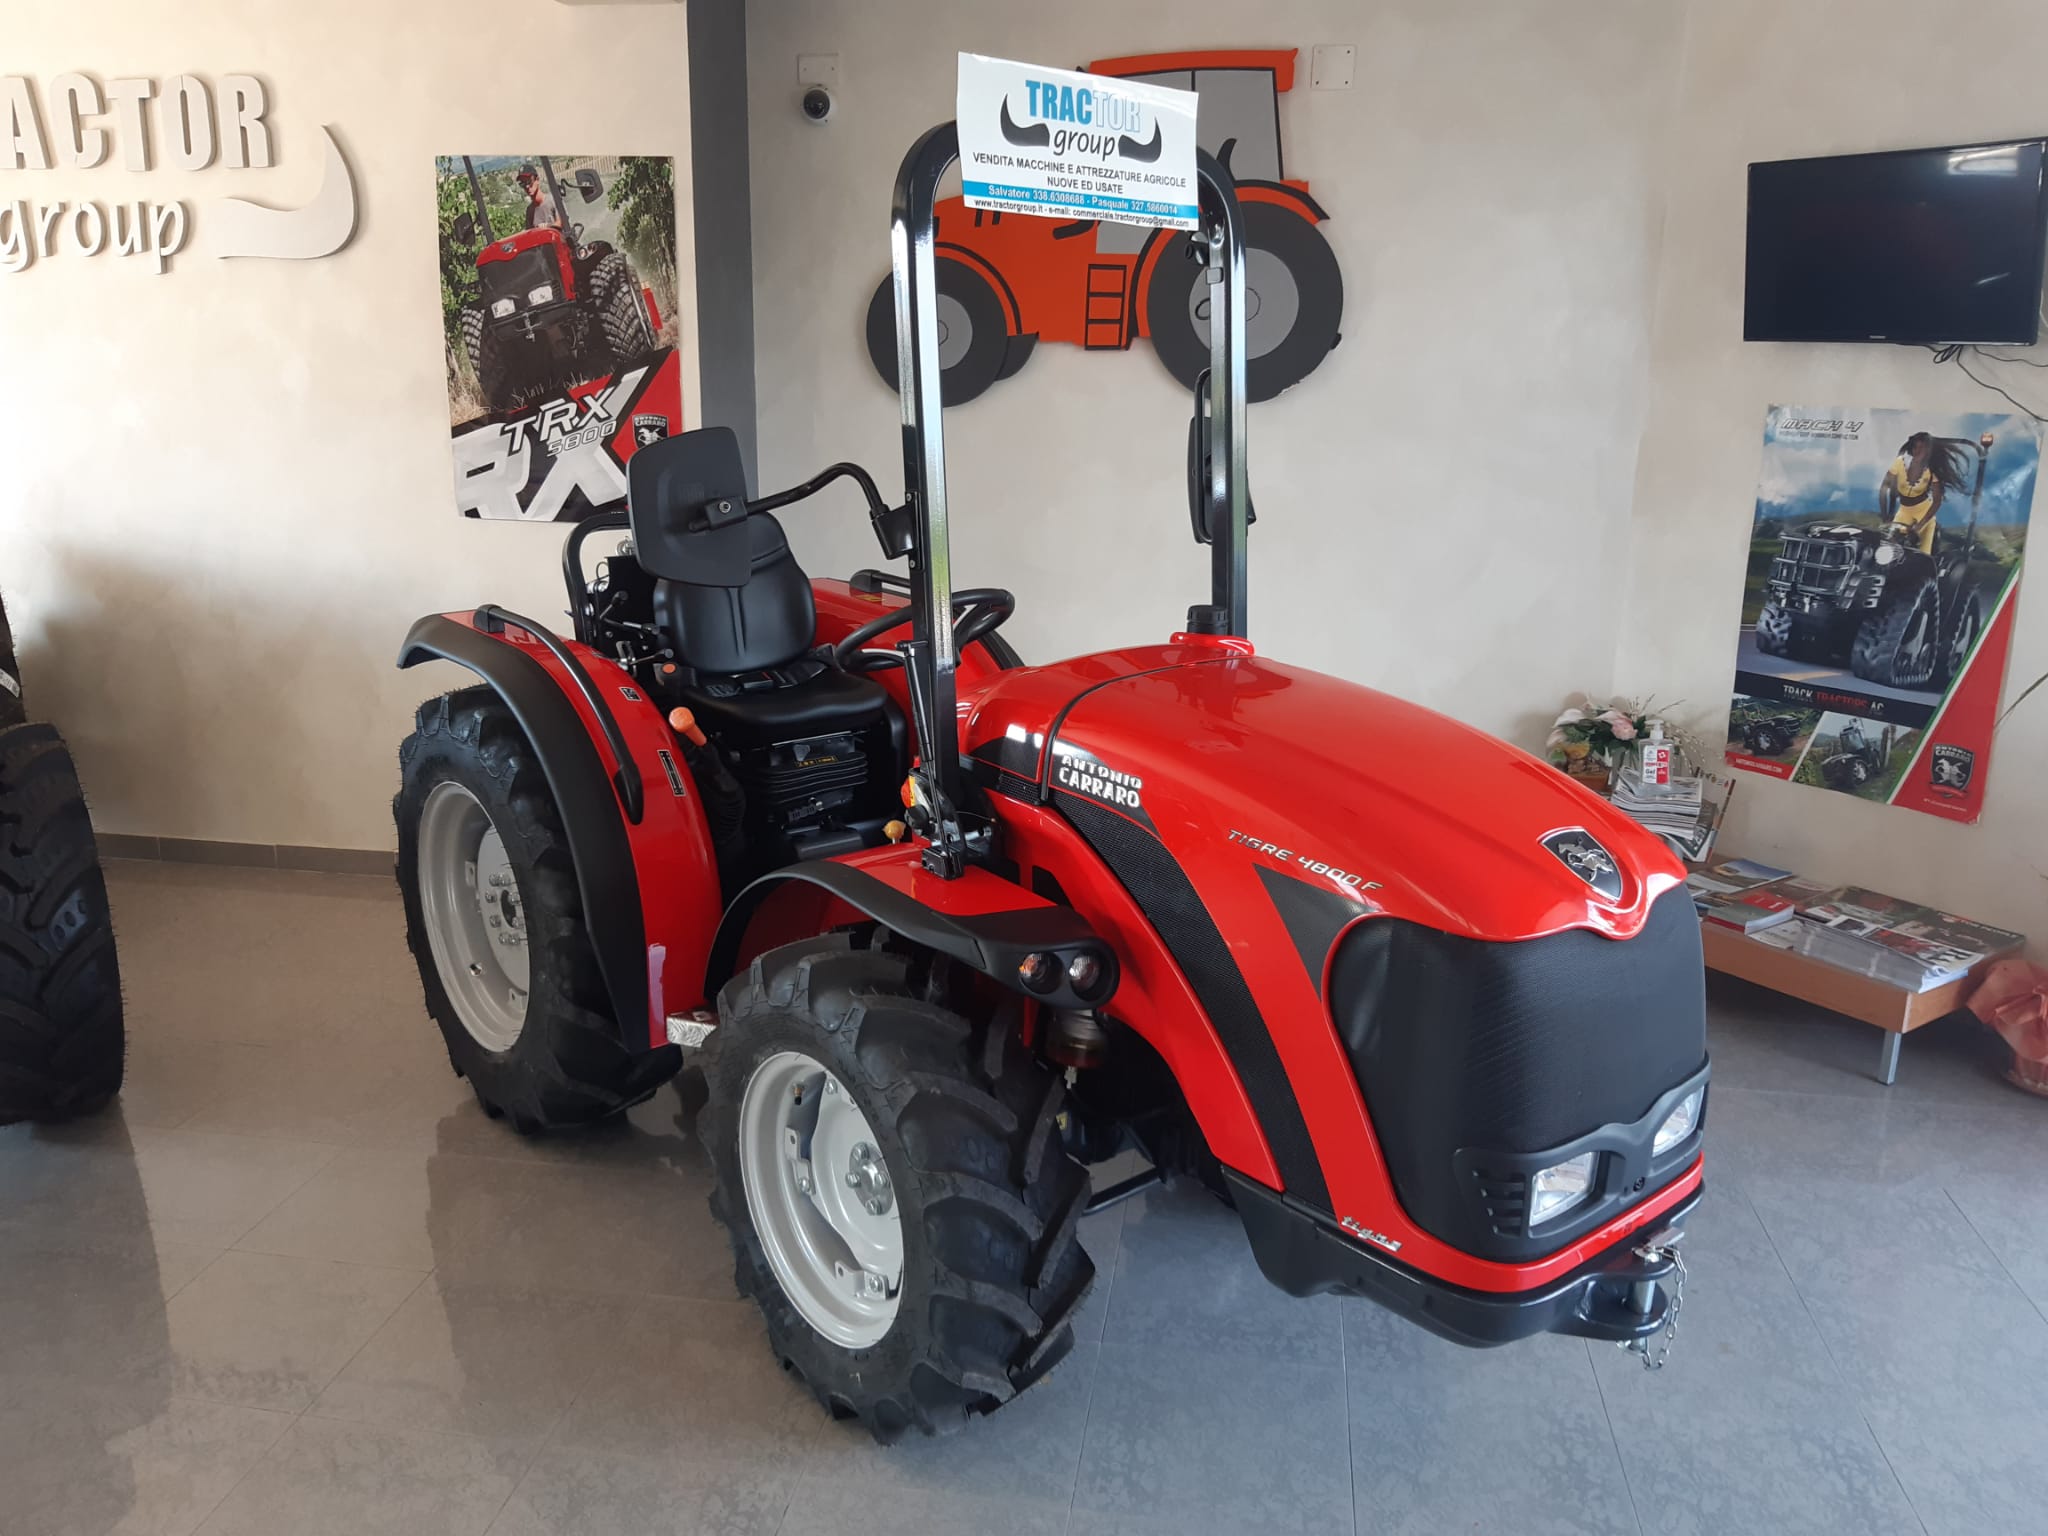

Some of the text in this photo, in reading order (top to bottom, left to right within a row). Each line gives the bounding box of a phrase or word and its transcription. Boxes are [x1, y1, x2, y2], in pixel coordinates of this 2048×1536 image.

[1025, 79, 1141, 133] TRACTOR
[1053, 129, 1115, 161] group
[973, 152, 1187, 188] VENDITA MACCHINE E ATTREZZATURE AGRICOLE
[1047, 176, 1124, 194] NUOVE ED USATE
[974, 198, 1044, 214] www.tractorgroup.it
[988, 184, 1030, 200] Salvatore
[1092, 196, 1129, 211] Pasquale
[546, 419, 617, 457] 5800
[1781, 418, 1864, 433] MACH 4
[1058, 766, 1140, 808] CARRARO
[1061, 753, 1142, 789] ANTONIO
[1227, 829, 1384, 890] TIGRE 4800 F
